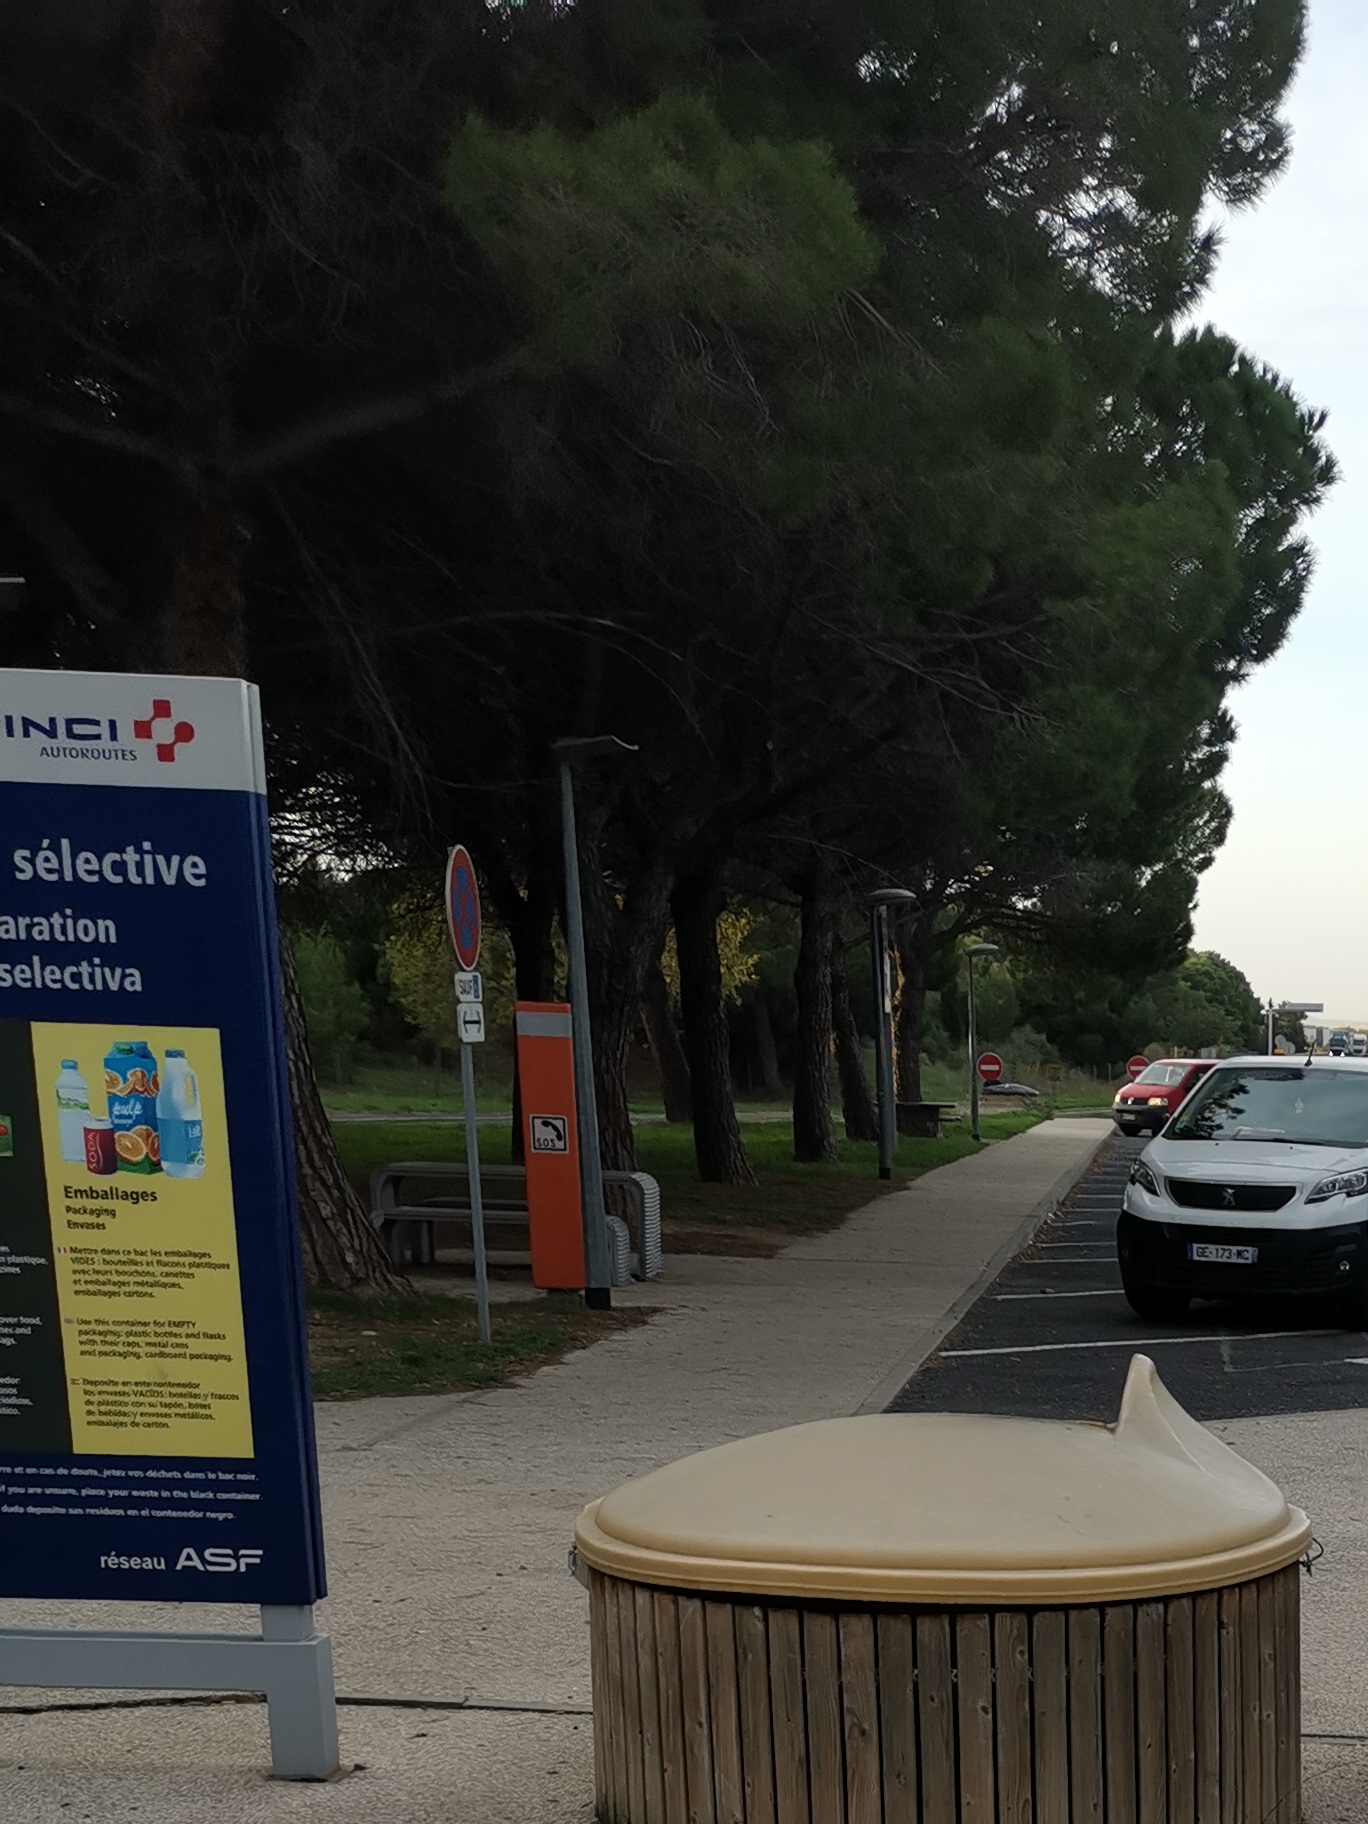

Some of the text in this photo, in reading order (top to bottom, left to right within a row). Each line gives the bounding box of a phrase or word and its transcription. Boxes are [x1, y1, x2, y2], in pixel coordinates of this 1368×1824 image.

[39, 746, 138, 762] AUTOROUTES
[13, 837, 207, 888] sélective
[0, 954, 143, 992] selectiva
[88, 1131, 98, 1170] SODA
[536, 1137, 557, 1149] SOS
[63, 1185, 158, 1204] Emballages
[65, 1205, 117, 1219] Packaging
[67, 1219, 107, 1231] Envases
[100, 1547, 263, 1573] réseau ASF
